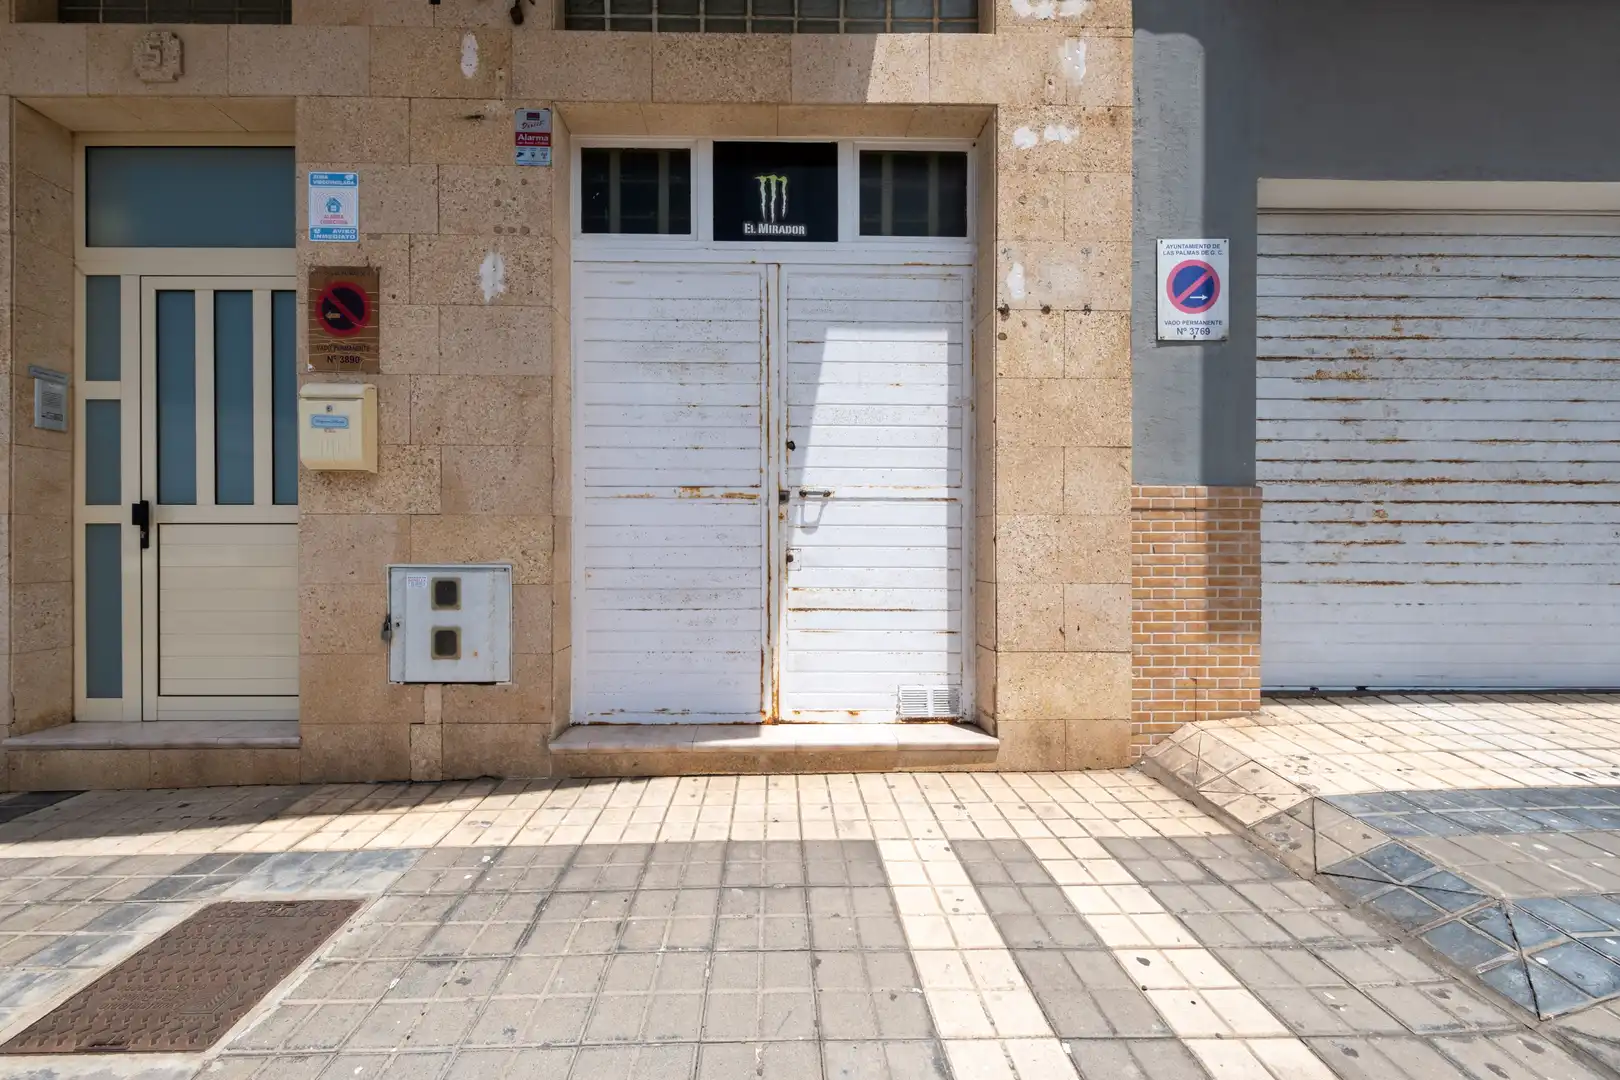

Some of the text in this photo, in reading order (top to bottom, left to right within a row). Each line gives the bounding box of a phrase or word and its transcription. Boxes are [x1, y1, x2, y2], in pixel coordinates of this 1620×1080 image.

[517, 133, 549, 141] Alarma
[1189, 327, 1211, 336] 3769
[339, 355, 361, 364] 3890
